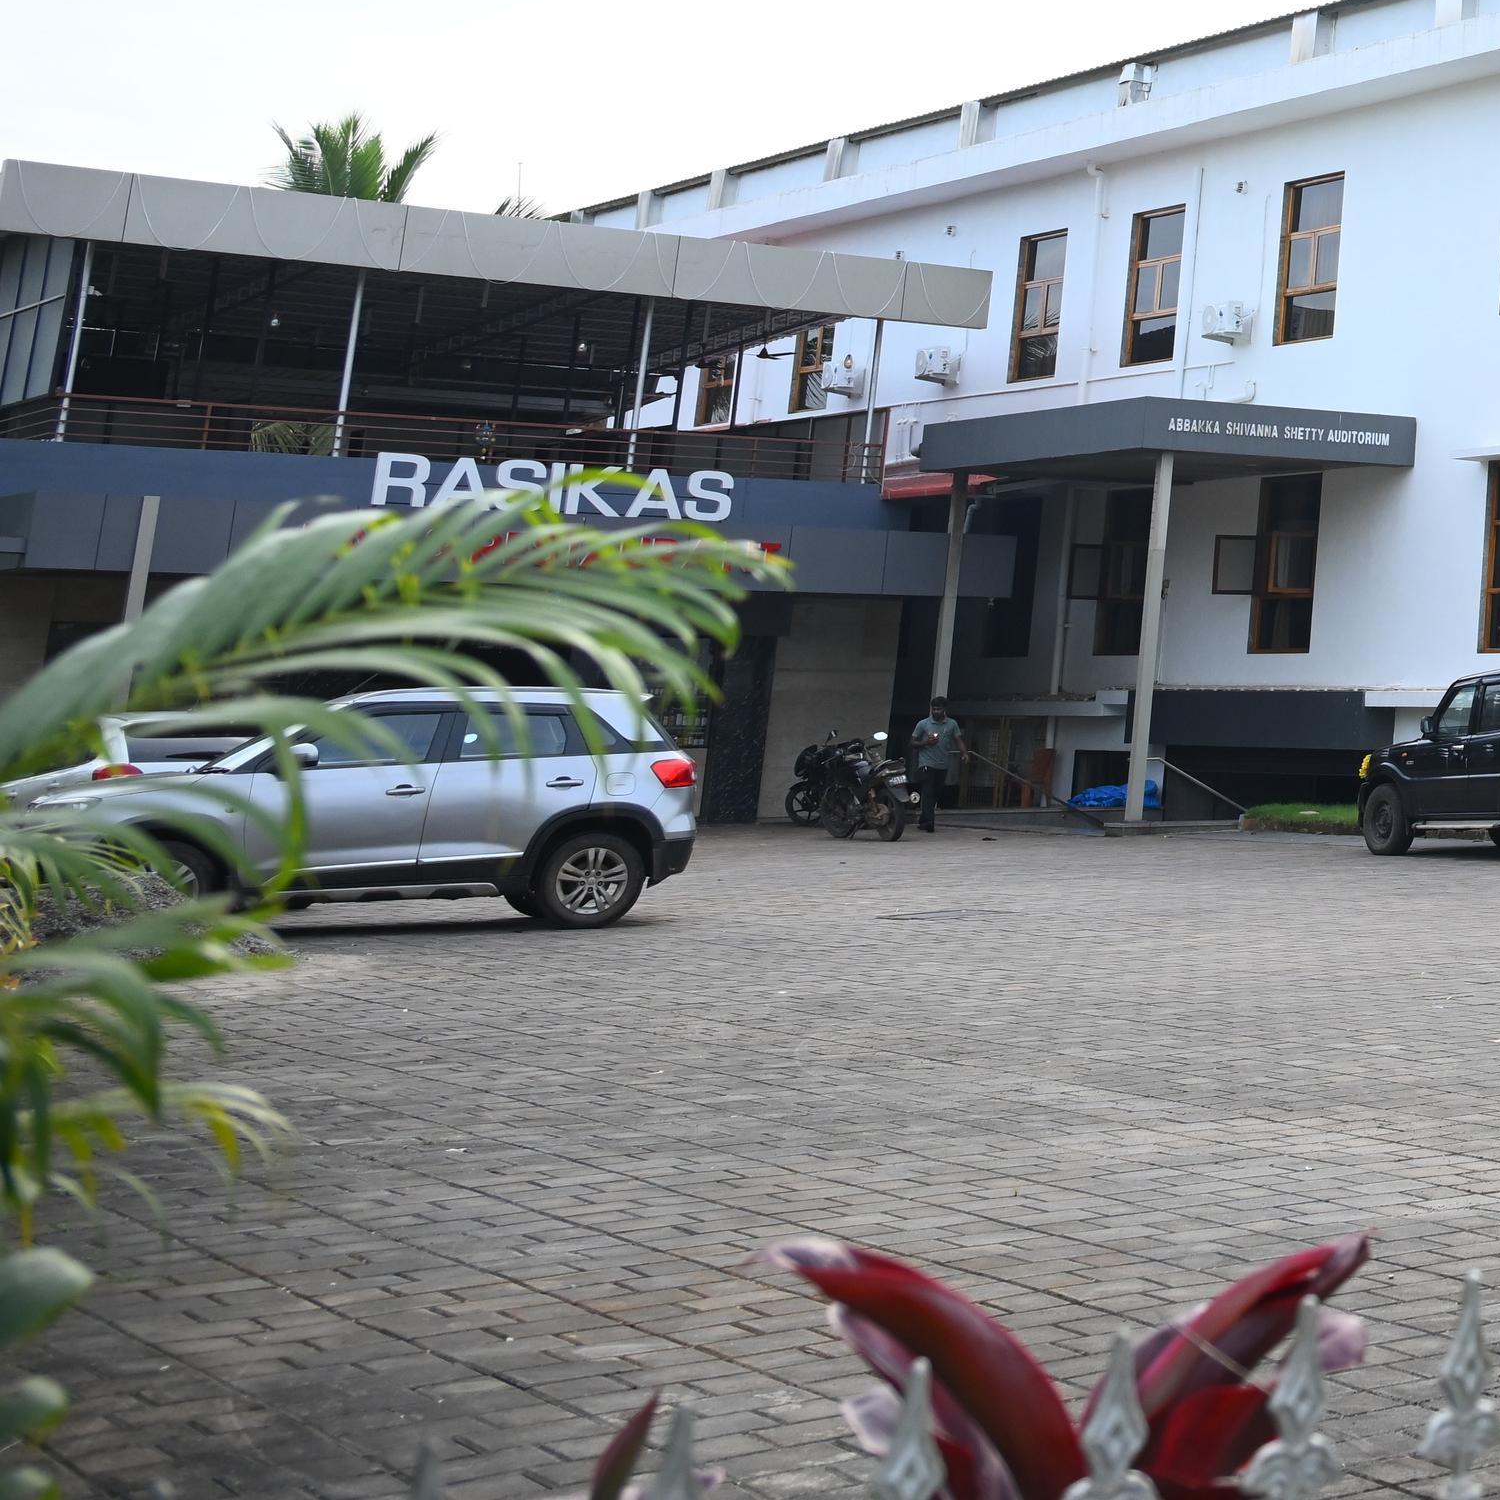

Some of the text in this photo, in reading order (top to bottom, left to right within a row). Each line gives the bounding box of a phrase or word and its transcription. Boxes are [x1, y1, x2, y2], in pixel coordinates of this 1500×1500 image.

[1168, 417, 1390, 446] ABBAKKA SHIVANNA SHETTY AUDITORIUM
[371, 451, 735, 522] RASIKAS
